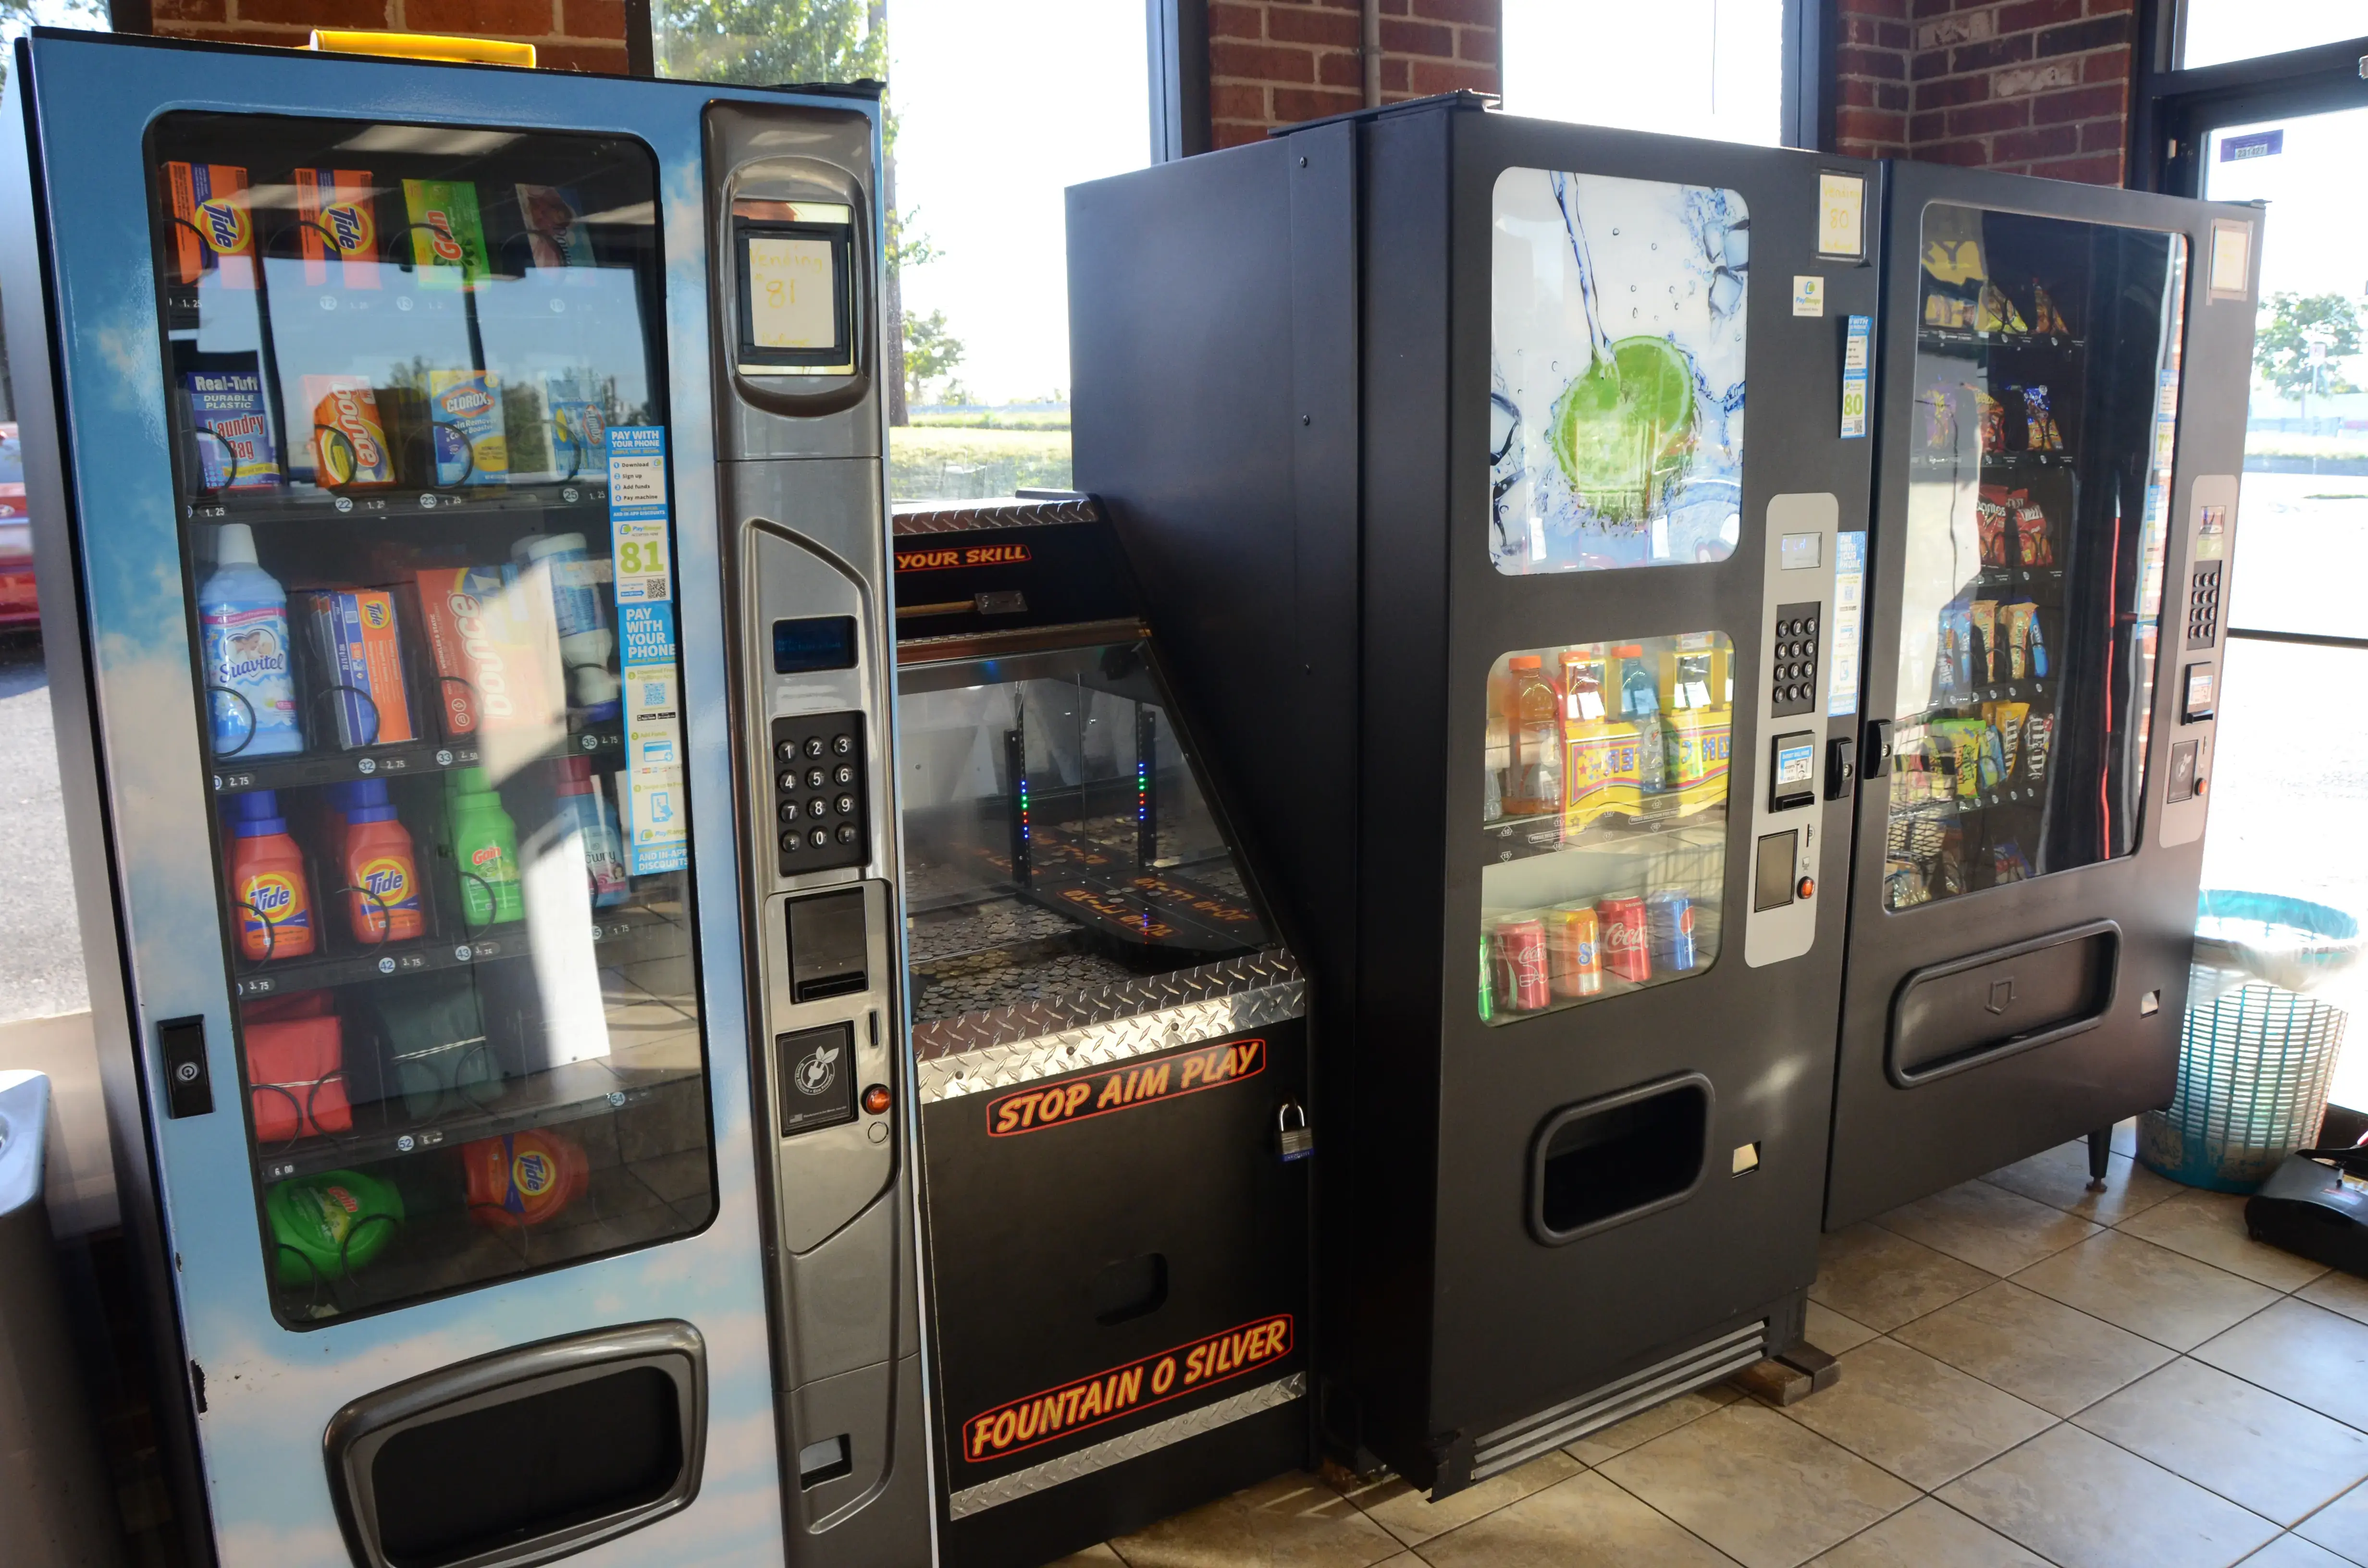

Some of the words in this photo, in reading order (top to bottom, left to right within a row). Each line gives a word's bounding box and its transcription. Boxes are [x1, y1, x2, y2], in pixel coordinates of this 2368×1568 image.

[202, 202, 238, 249] Tide
[328, 206, 360, 249] Tide
[750, 244, 823, 274] Vending
[766, 279, 796, 309] 81
[446, 392, 488, 413] CLOROX
[1844, 393, 1863, 416] 80
[208, 414, 264, 441] Laundry
[611, 430, 630, 440] PAY
[632, 430, 659, 439] WITH
[421, 496, 435, 506] 23
[564, 490, 578, 500] 25
[336, 500, 352, 510] 22
[620, 541, 664, 574] 81
[897, 551, 960, 569] YOUR
[965, 546, 1026, 564] SKILL
[365, 602, 384, 626] Tide
[626, 608, 652, 620] PAY
[626, 619, 663, 633] WITH
[1796, 623, 1801, 633] 2
[1809, 621, 1814, 632] 3
[627, 632, 666, 646] YOUR
[628, 644, 676, 658] PHONE
[1780, 646, 1786, 657] 4
[1794, 644, 1800, 655] 5
[1808, 642, 1813, 653] 6
[219, 653, 284, 683] Suavitel
[1780, 668, 1785, 677] 7
[1793, 665, 1799, 676] 8
[1807, 664, 1813, 675] 9
[1792, 687, 1797, 698] 0
[582, 738, 597, 747] 35
[812, 742, 820, 755] 2
[839, 739, 848, 752] 3
[437, 753, 451, 762] 33
[785, 746, 791, 759] 1
[359, 761, 374, 771] 32
[785, 775, 793, 789] 4
[813, 772, 821, 785] 5
[840, 769, 849, 783] 6
[815, 802, 823, 815] 8
[842, 798, 850, 812] 9
[788, 806, 795, 819] 7
[816, 832, 824, 845] 0
[472, 845, 502, 865] Gain
[584, 850, 616, 864] owny
[639, 852, 657, 862] AND
[365, 870, 403, 900] Tide
[250, 884, 290, 917] Tide
[456, 948, 470, 958] 43
[379, 961, 394, 969] 42
[996, 1082, 1092, 1133] STOP
[1097, 1063, 1171, 1109] AIM
[1181, 1041, 1259, 1089] PLAY
[611, 1094, 624, 1104] 54
[398, 1139, 413, 1149] 52
[519, 1154, 545, 1191] Tide
[971, 1365, 1145, 1458] FOUNTAIN
[1151, 1356, 1176, 1394] O
[1183, 1319, 1287, 1385] SILVER
